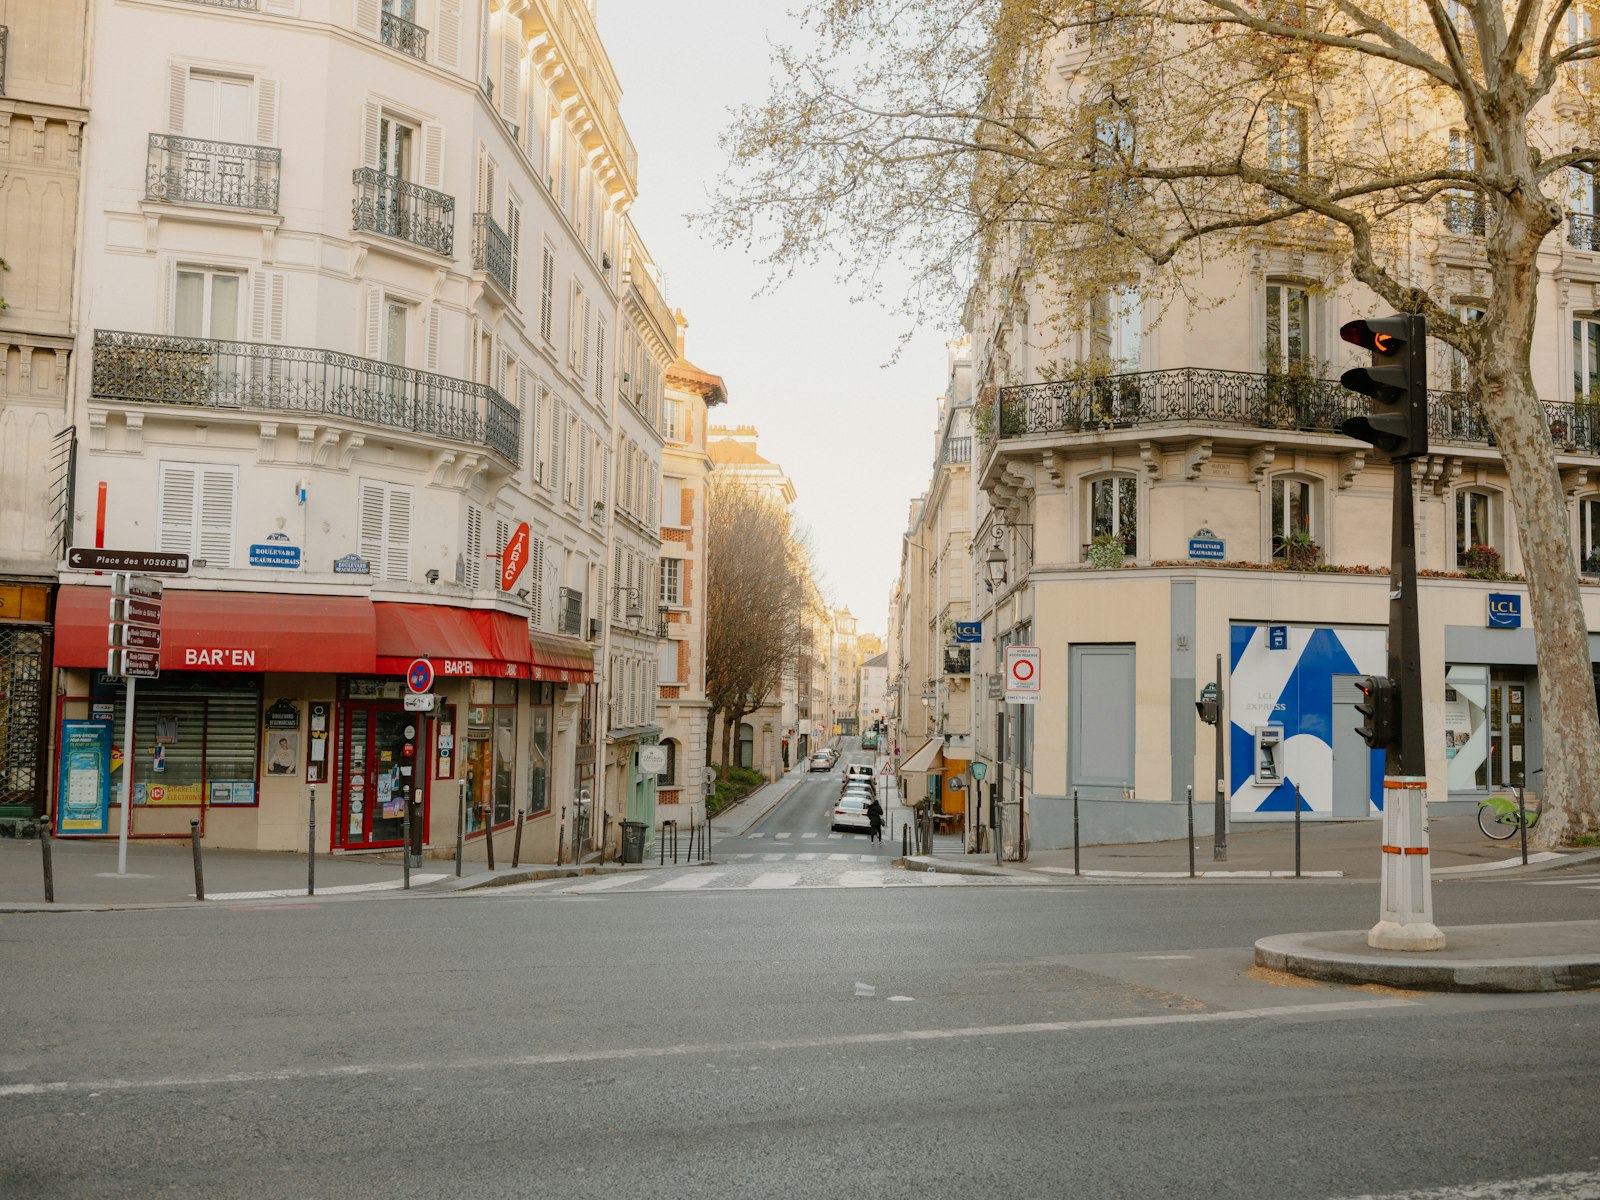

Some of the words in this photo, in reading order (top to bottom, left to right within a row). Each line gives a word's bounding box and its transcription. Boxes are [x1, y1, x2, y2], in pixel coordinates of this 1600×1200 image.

[255, 548, 295, 556] BOULEVARD
[505, 532, 526, 580] TABAC
[96, 555, 120, 564] Place
[124, 557, 138, 565] des
[143, 558, 177, 567] VOSGES
[250, 556, 300, 565] BEAUMARCHAIS
[1491, 601, 1518, 613] LCL
[958, 626, 979, 634] LCL
[185, 648, 256, 667] BAR'EN
[1257, 692, 1274, 700] LCL
[1246, 702, 1286, 711] EXPRESS
[151, 788, 164, 798] IC!
